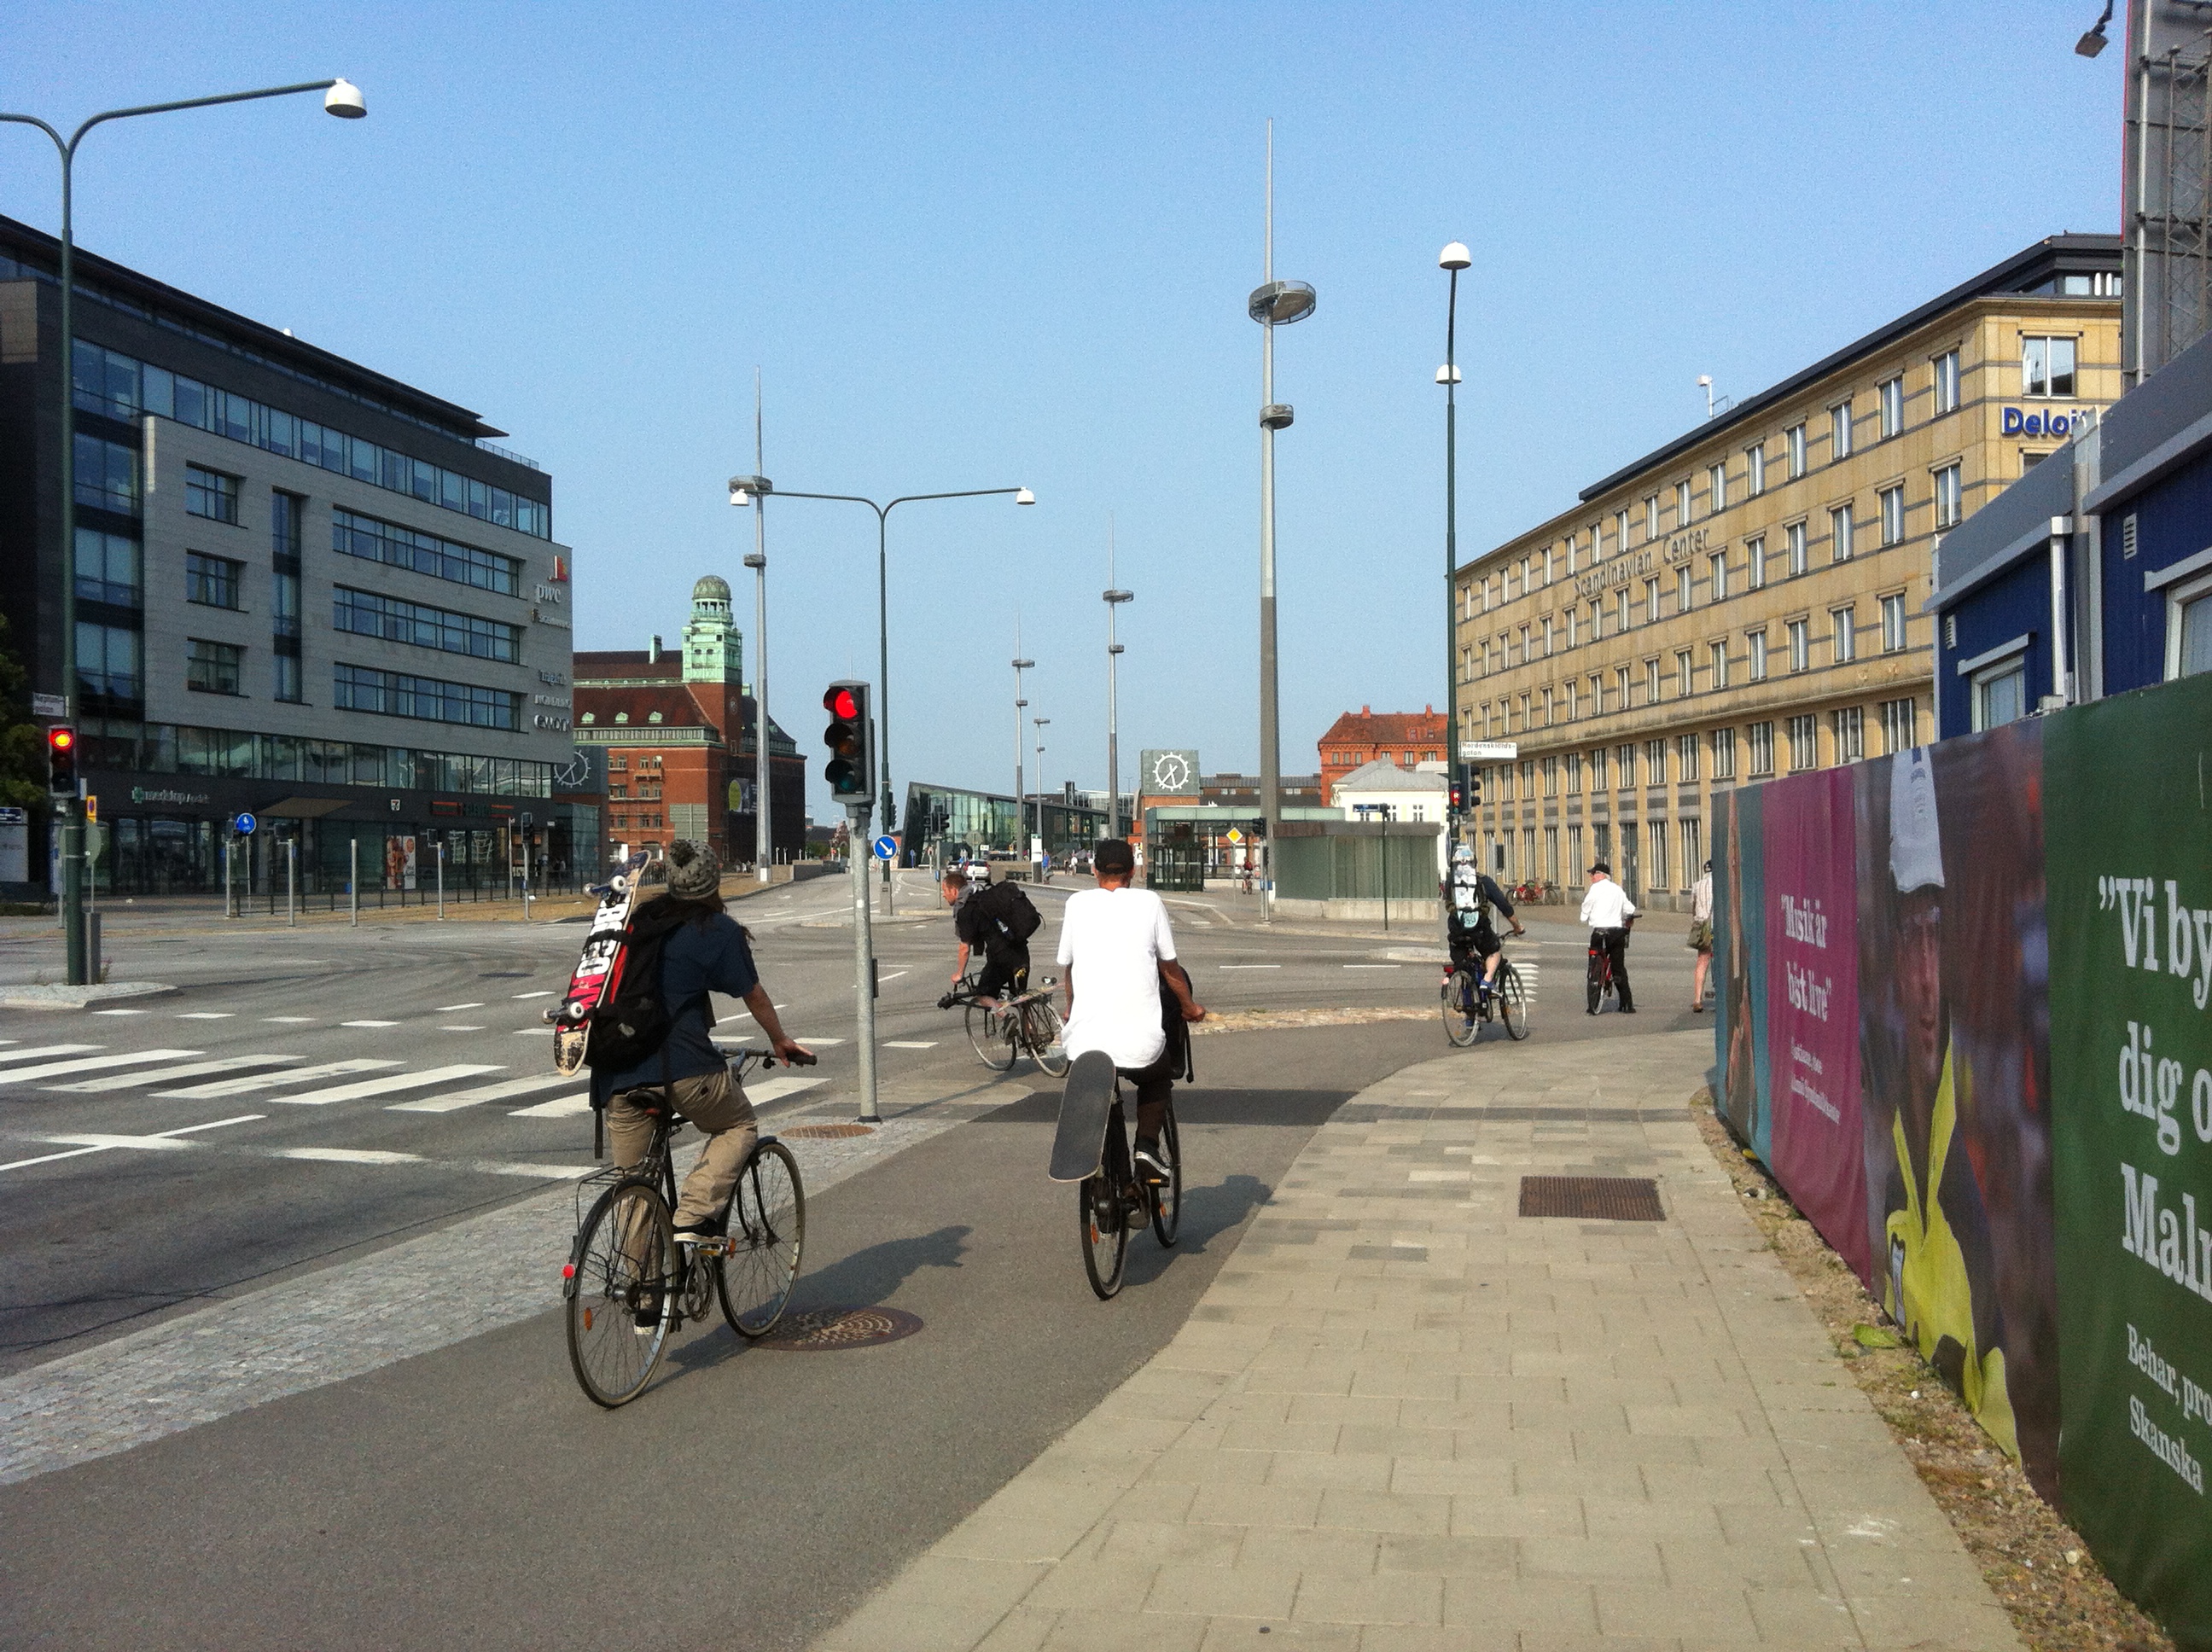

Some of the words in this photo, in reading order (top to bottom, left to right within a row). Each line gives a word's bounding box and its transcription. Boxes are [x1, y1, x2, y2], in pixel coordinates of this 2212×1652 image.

[535, 584, 561, 604] pwc
[1575, 551, 1653, 596] Scandinavian
[1664, 528, 1709, 564] Center
[1815, 899, 1827, 949] är
[2164, 880, 2212, 1010] by
[2119, 1021, 2183, 1156] dig
[2129, 1394, 2203, 1497] Skanska
